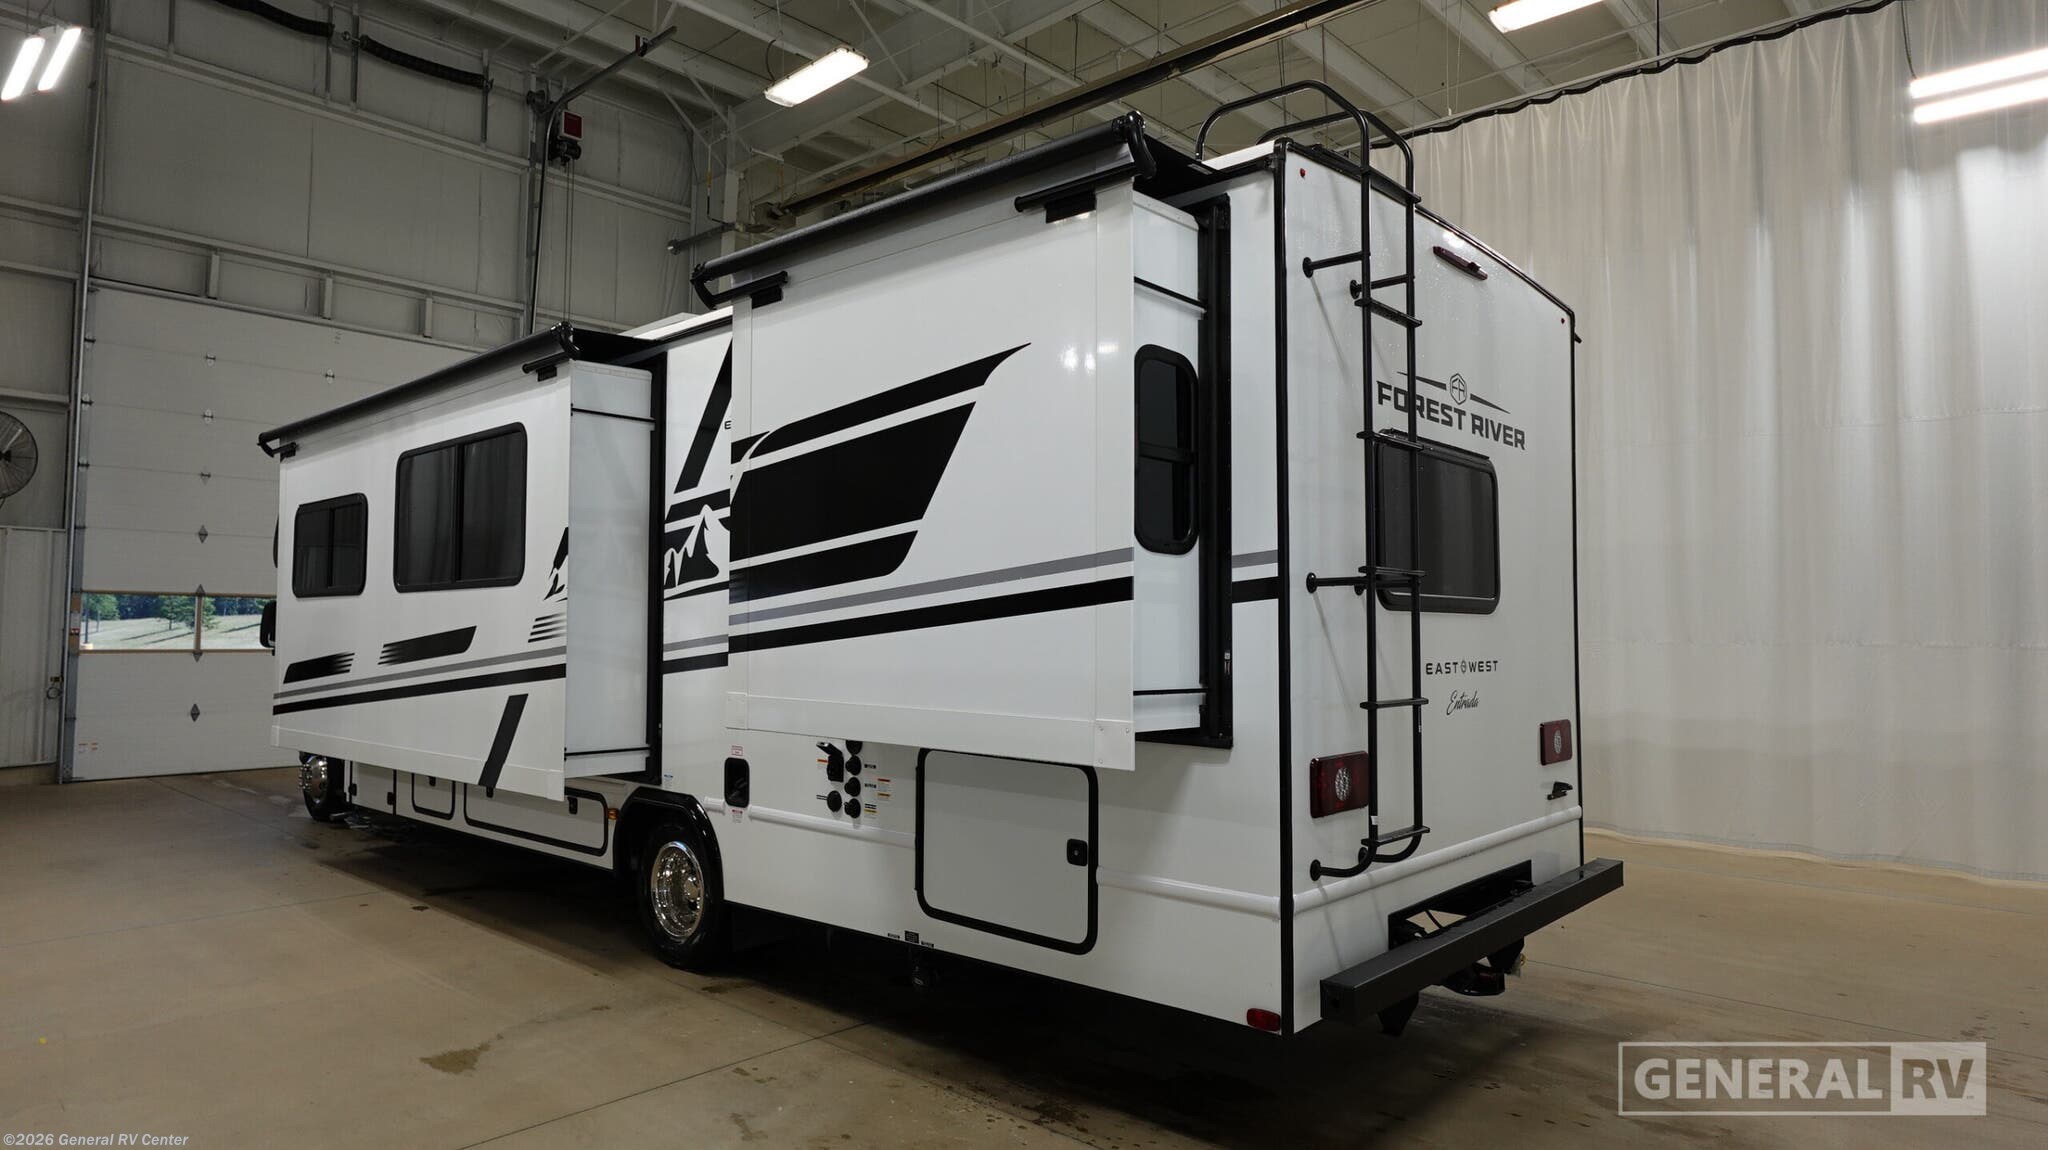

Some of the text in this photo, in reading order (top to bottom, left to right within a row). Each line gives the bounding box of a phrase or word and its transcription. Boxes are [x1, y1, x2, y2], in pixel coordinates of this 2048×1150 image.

[1376, 380, 1525, 450] FOREST RIVER
[1425, 660, 1498, 675] EAST WEST
